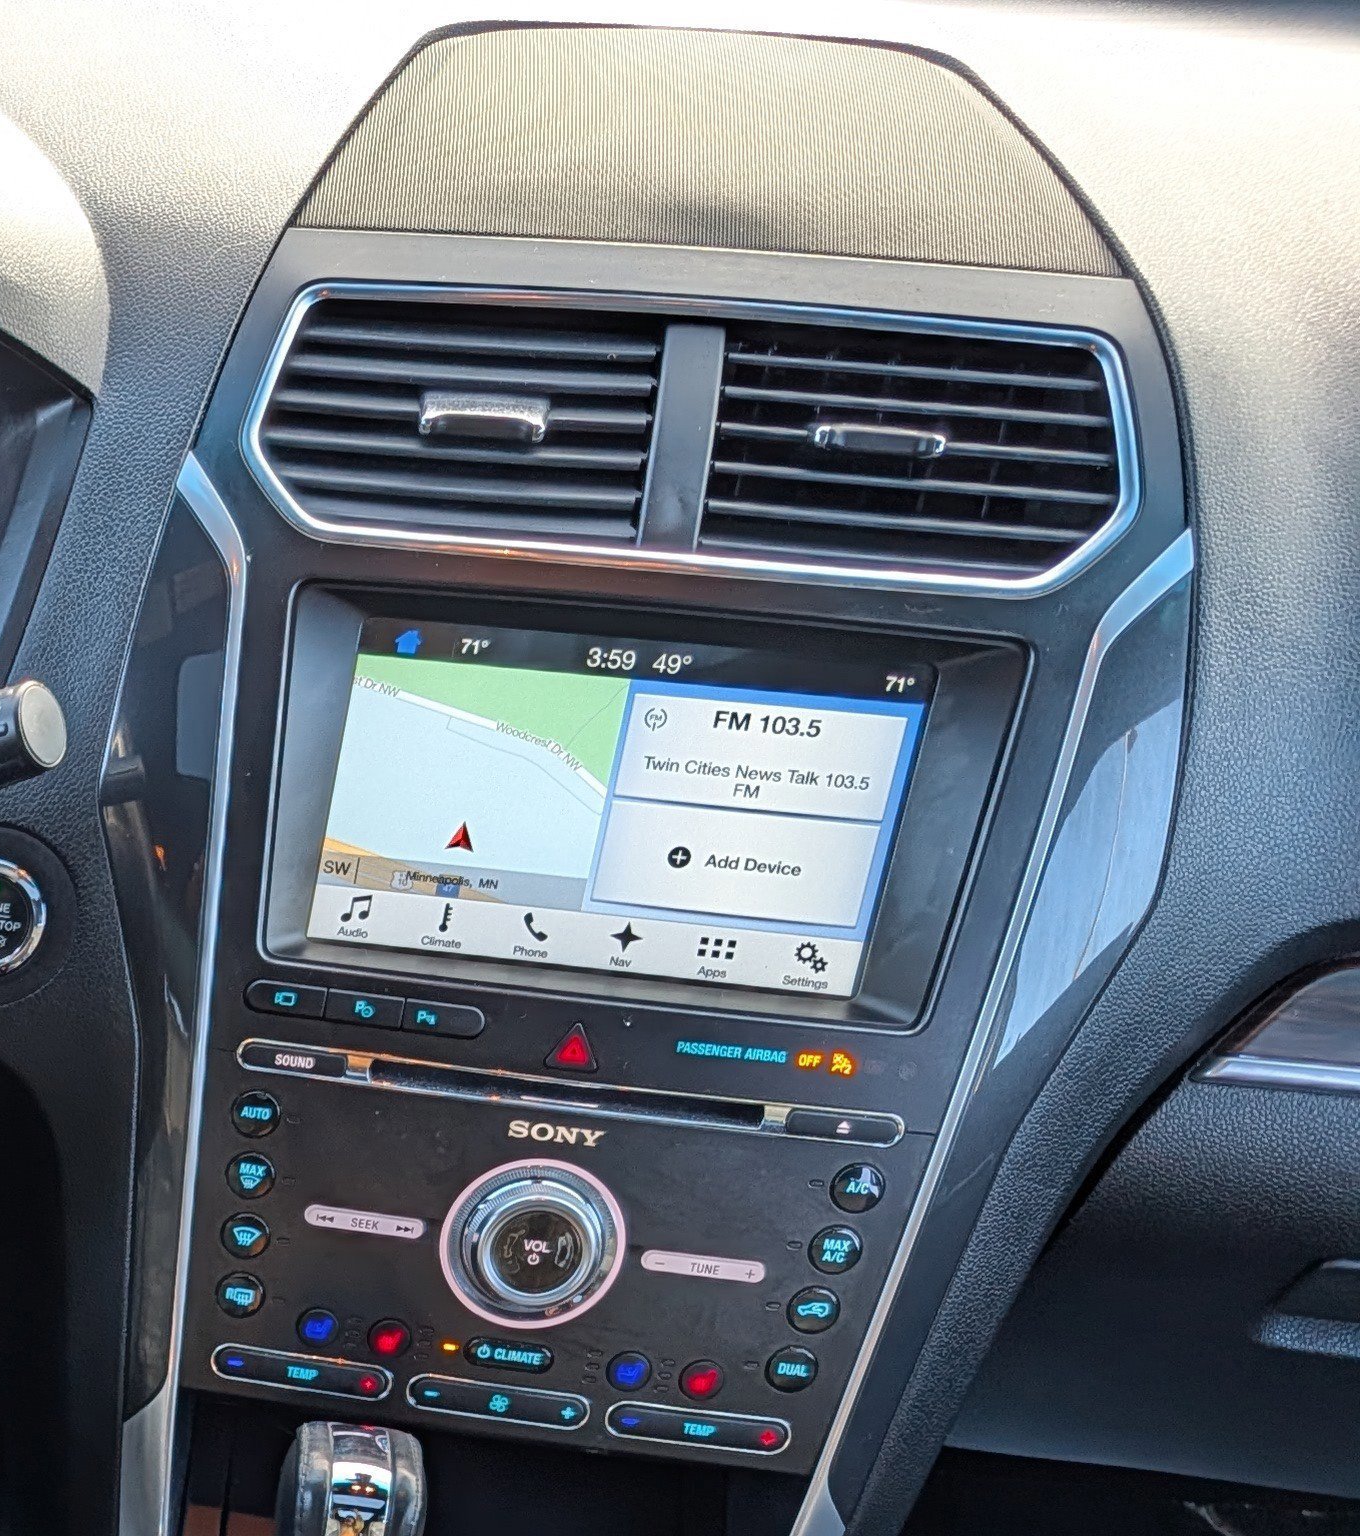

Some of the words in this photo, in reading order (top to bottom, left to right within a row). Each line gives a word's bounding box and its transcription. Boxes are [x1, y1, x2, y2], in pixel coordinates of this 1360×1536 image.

[586, 647, 637, 671] 3:59
[363, 677, 378, 690] Dr
[379, 683, 401, 698] NW
[713, 710, 752, 731] FM
[760, 717, 822, 738] 103.5
[495, 720, 552, 750] Woodcrest
[549, 741, 565, 757] Dr
[562, 752, 583, 772] NW
[643, 755, 680, 774] Twin
[684, 759, 730, 778] Cities
[735, 765, 782, 782] News
[787, 769, 819, 787] Talk
[825, 773, 870, 791] 103.5
[732, 784, 760, 799] FM
[322, 860, 352, 876] SW
[704, 854, 740, 872] Add
[743, 858, 802, 878] Device
[478, 877, 499, 890] MN
[337, 926, 369, 939] Audio
[420, 935, 462, 949] Climate
[512, 945, 548, 959] Phone
[609, 956, 632, 968] Nav
[696, 966, 727, 979] Apps
[782, 975, 828, 990] Settings
[274, 1053, 316, 1069] SOUND
[676, 1041, 741, 1059] PASSENGER
[744, 1047, 787, 1063] AIRBAG
[797, 1053, 822, 1069] OFF
[241, 1106, 272, 1121] AUTO
[507, 1119, 606, 1147] SONY
[239, 1163, 266, 1177] MAX
[846, 1181, 869, 1195] A/C
[350, 1217, 379, 1231] SEEK
[523, 1238, 551, 1254] VOL
[822, 1238, 851, 1252] MAX
[821, 1250, 846, 1264] A/C
[690, 1262, 721, 1276] TUNE
[493, 1348, 543, 1366] CLIMATE
[286, 1366, 318, 1381] TEMP
[777, 1362, 808, 1377] DUAL
[682, 1422, 716, 1438] TEMP
